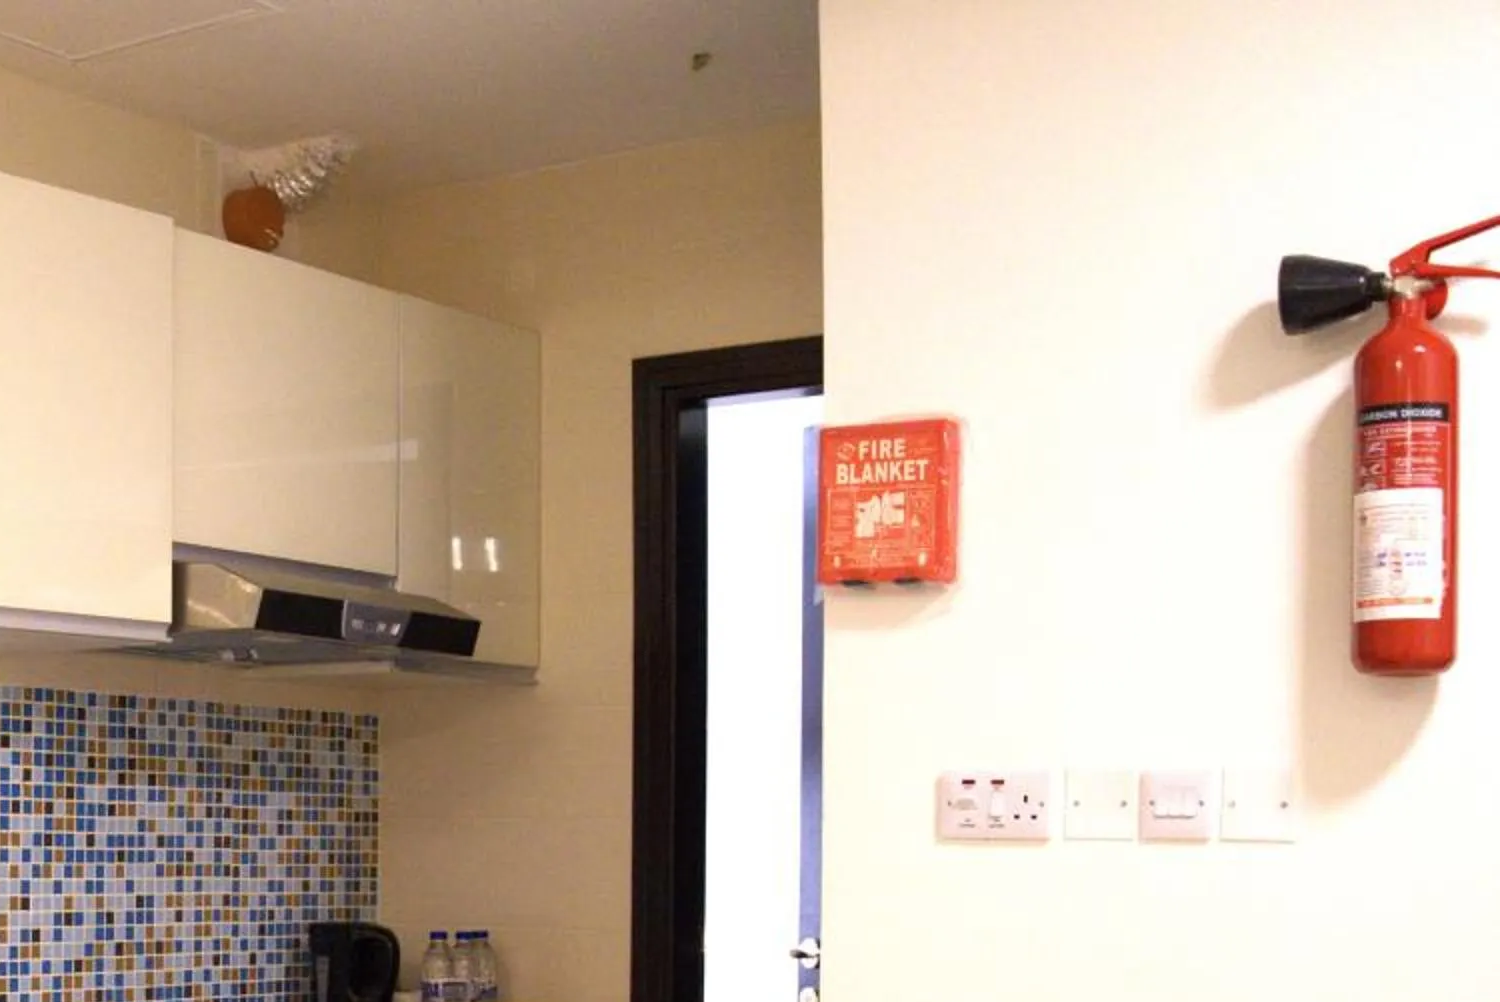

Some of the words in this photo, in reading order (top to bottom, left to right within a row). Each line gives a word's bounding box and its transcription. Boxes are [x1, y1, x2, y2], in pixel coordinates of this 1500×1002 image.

[1400, 407, 1442, 419] DIOXIDE
[858, 438, 907, 461] FIRE
[835, 459, 929, 485] BLANKET
